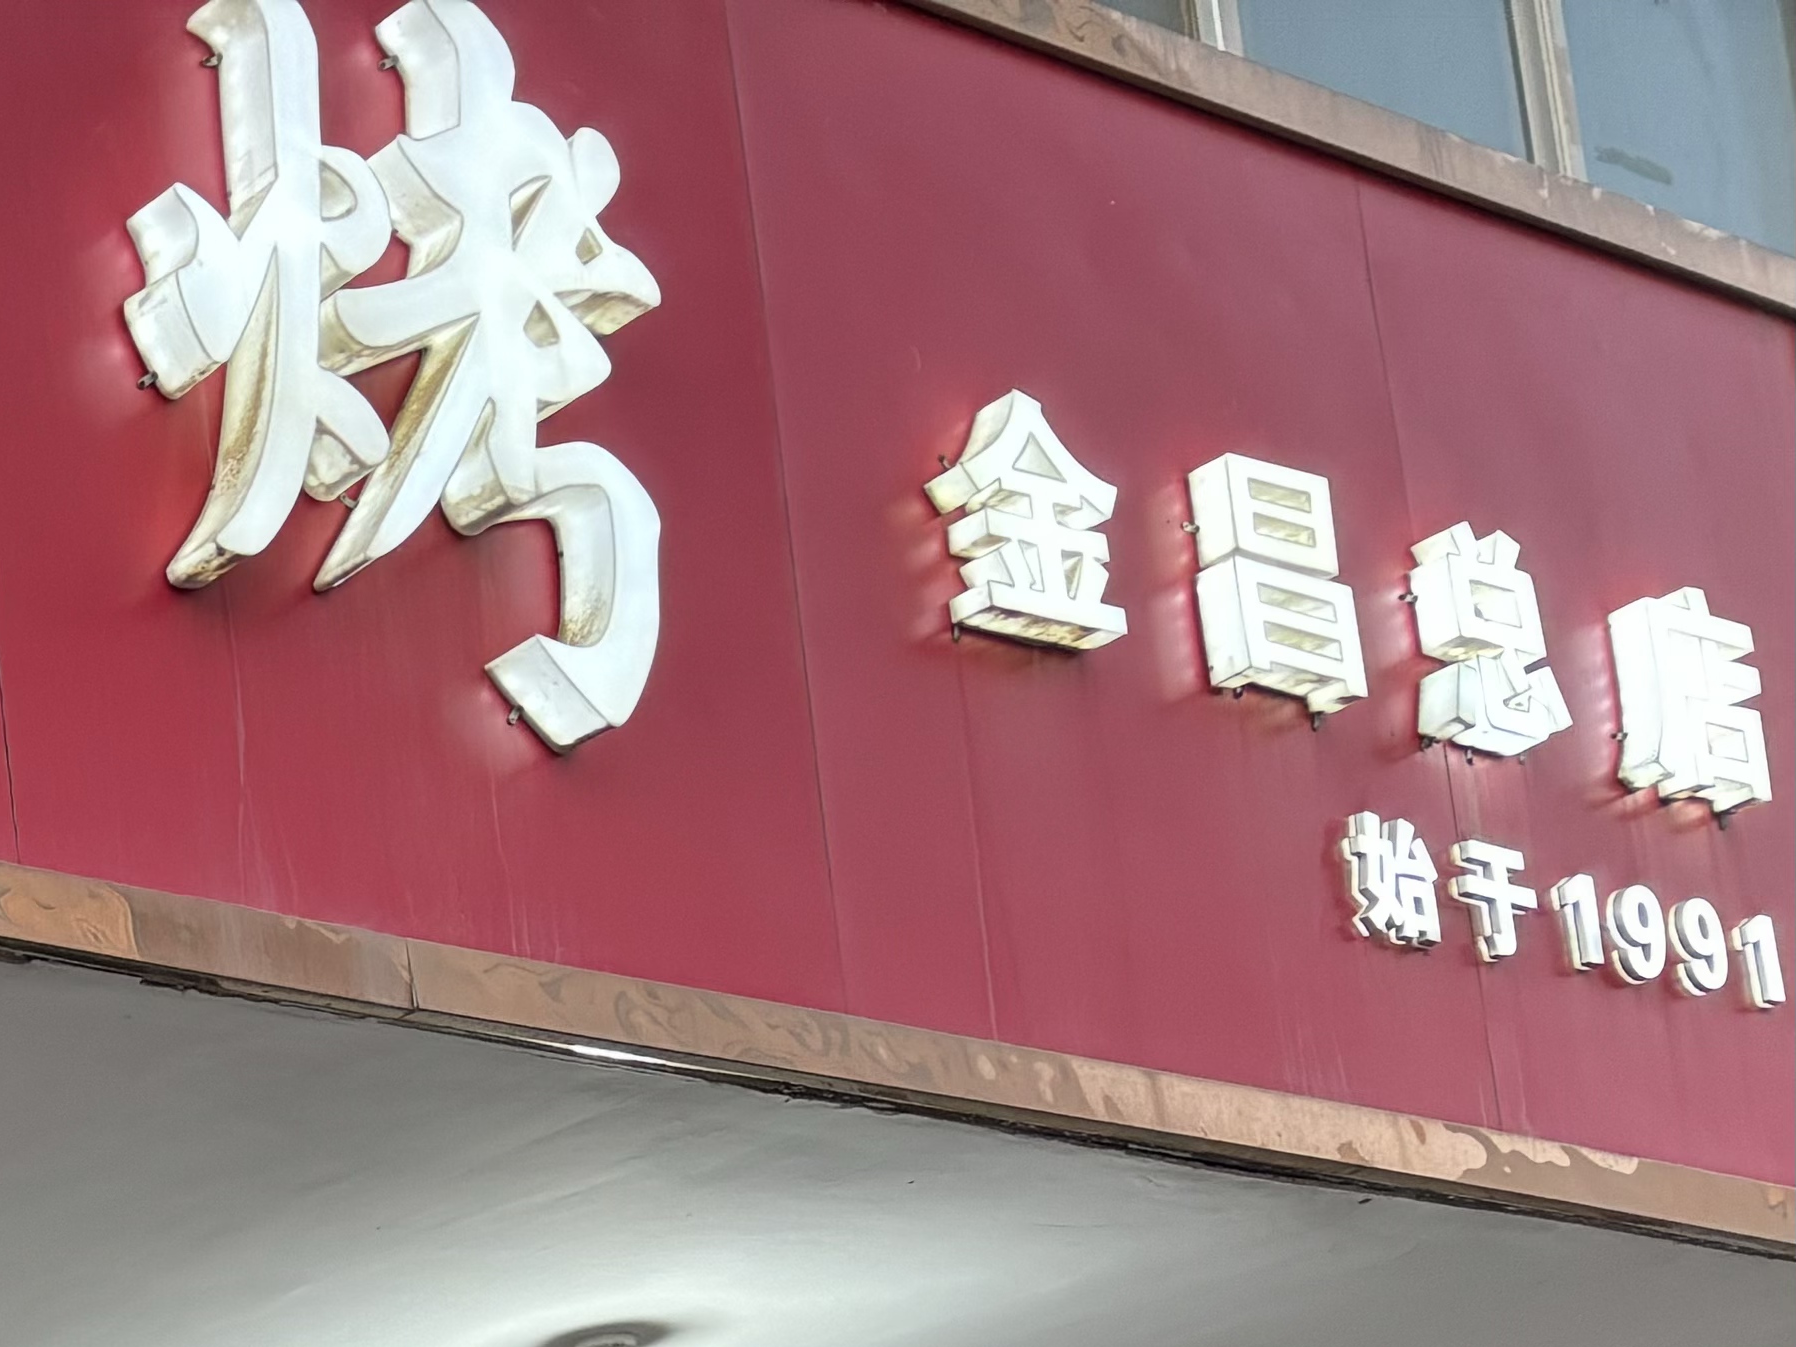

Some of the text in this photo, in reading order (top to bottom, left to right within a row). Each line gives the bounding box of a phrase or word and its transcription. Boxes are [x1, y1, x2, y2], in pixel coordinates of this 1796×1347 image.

[924, 388, 1773, 814] 金昌总店
[1341, 809, 1787, 1010] 始于1991
